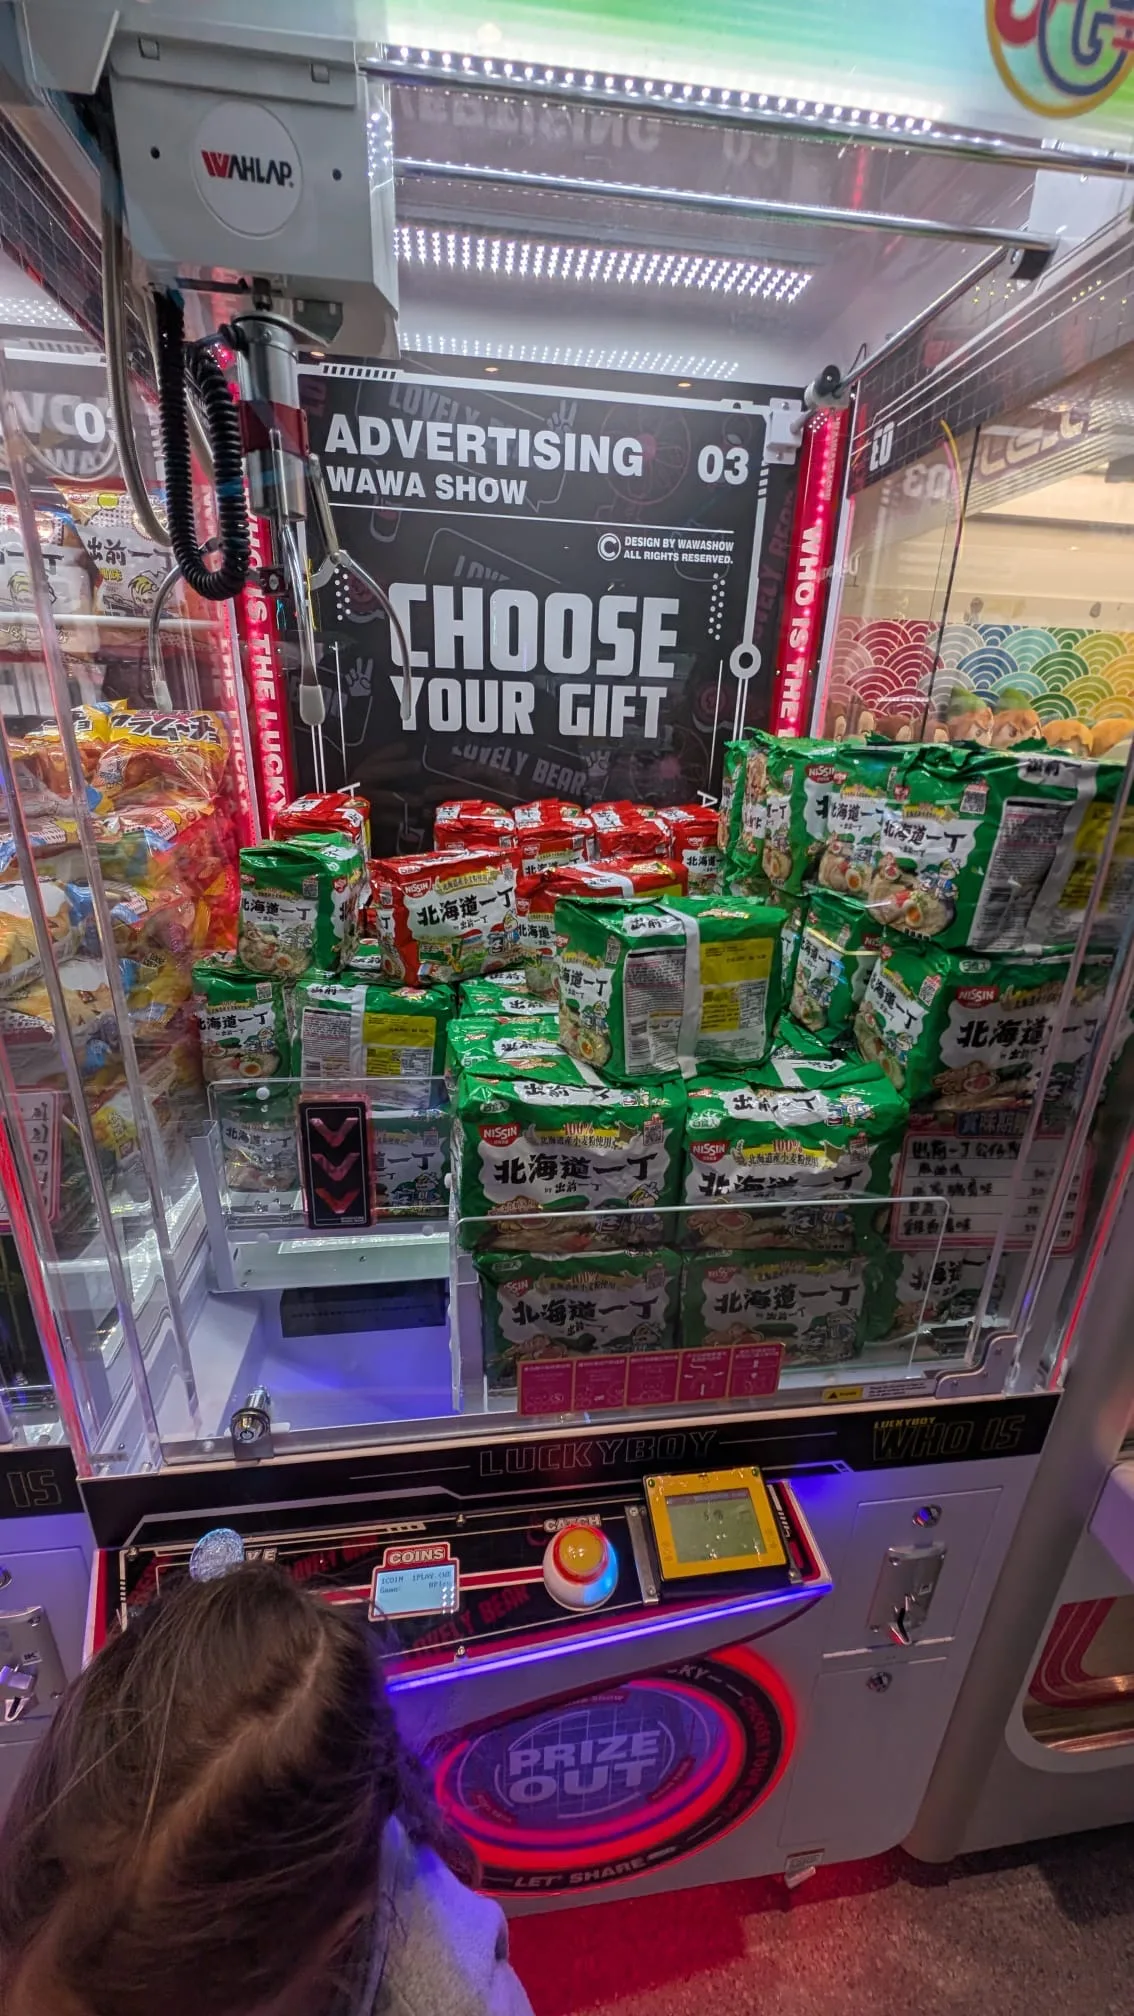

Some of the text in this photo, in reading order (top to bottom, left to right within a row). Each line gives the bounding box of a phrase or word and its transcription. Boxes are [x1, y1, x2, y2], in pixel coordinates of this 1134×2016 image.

[325, 414, 644, 477] ADVERTISING
[697, 445, 749, 485] 03
[327, 466, 527, 505] WAWA SHOW
[624, 536, 734, 552] DESIGN BY WAWASHOW
[624, 550, 733, 564] ALL RIGHTS RESERVED.
[794, 526, 823, 606] WHO
[245, 586, 268, 622] IS
[388, 582, 680, 679] CHOOSE
[789, 617, 811, 650] IS
[253, 634, 276, 700] THE
[780, 656, 806, 719] THE
[390, 676, 668, 739] YOUR GIFT
[259, 711, 289, 814] LUCKY
[532, 757, 588, 797] BEAR
[404, 882, 429, 894] NISSIN
[417, 887, 514, 927] 北海道一丁
[958, 988, 994, 1000] NISSIN
[483, 1128, 518, 1142] NISSIN
[692, 1144, 726, 1156] NISSIN
[494, 1152, 658, 1185] 北海道一丁
[512, 1296, 659, 1326] 北海道一丁
[714, 1283, 861, 1314] 北海道一丁
[479, 1430, 717, 1477] LUCKYBOY
[872, 1415, 1026, 1461] WHO IS
[388, 1547, 446, 1565] COINS
[508, 1730, 662, 1777] PRIZE
[508, 1757, 657, 1804] OUT
[569, 1856, 646, 1884] SHARE
